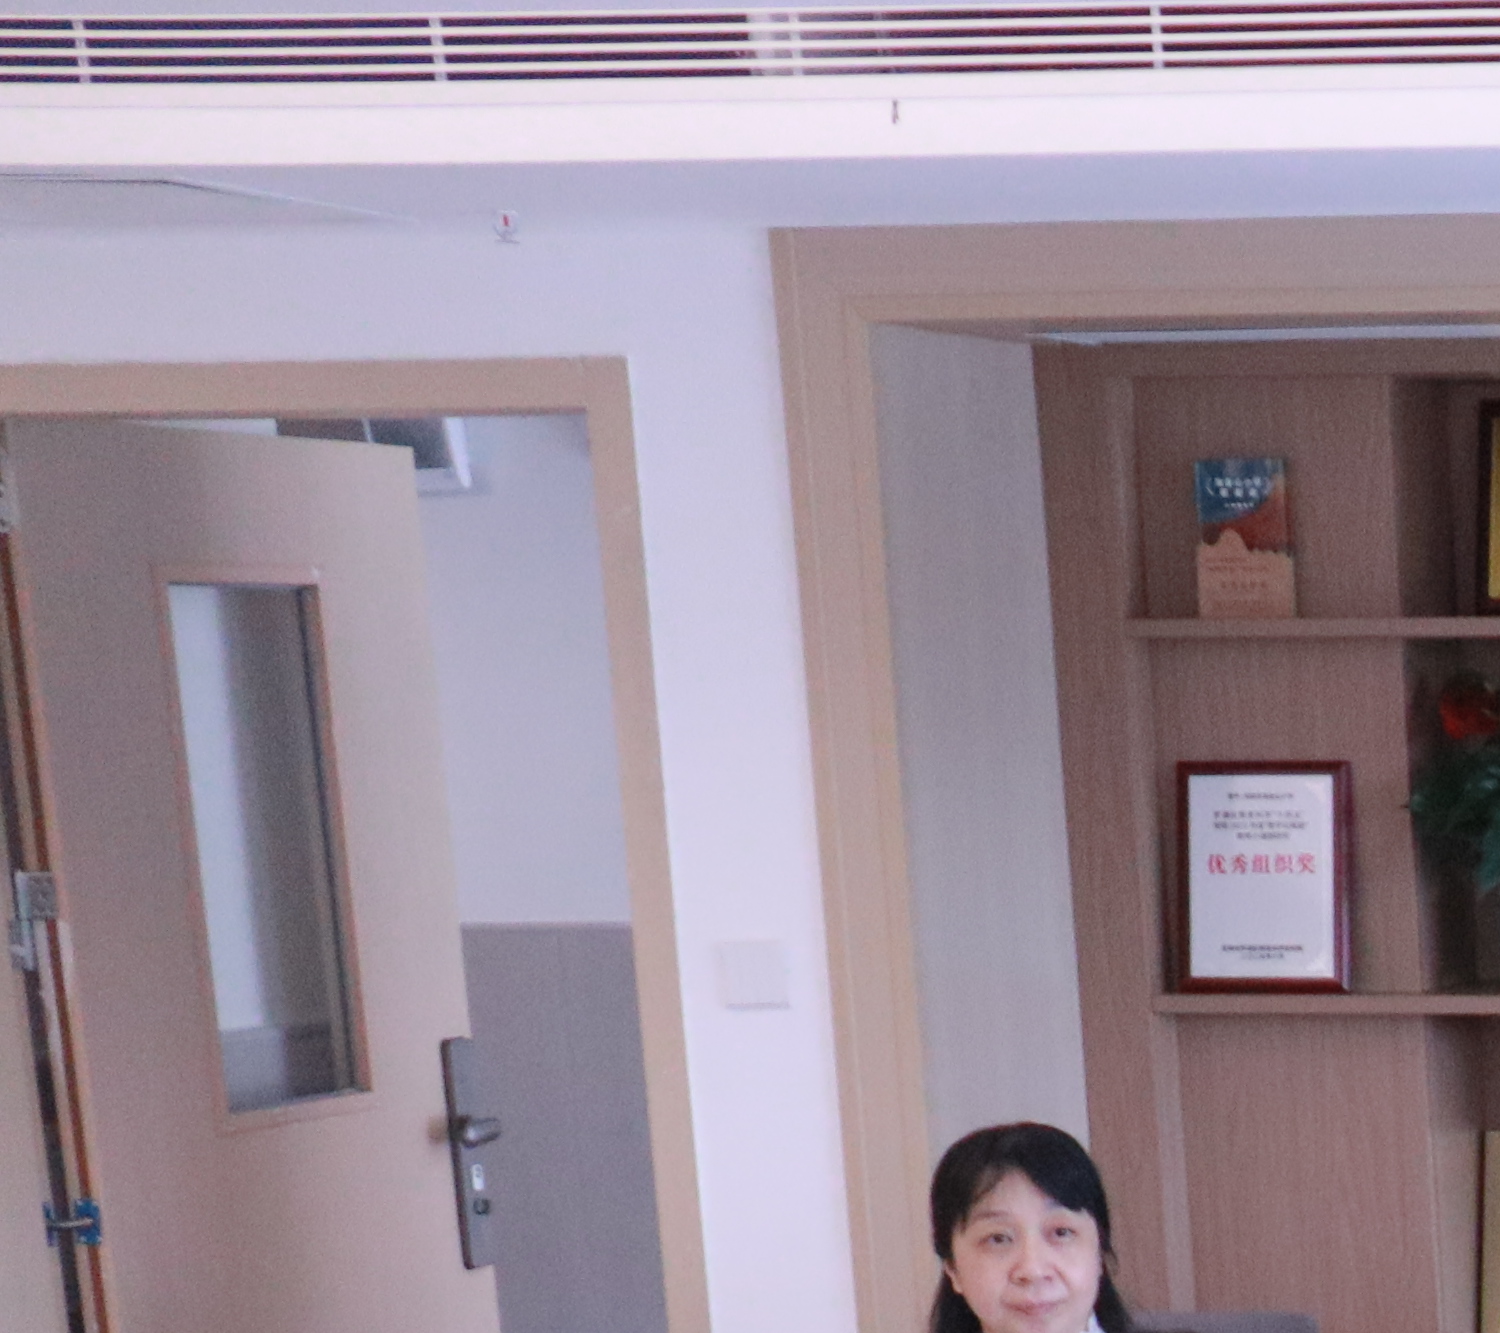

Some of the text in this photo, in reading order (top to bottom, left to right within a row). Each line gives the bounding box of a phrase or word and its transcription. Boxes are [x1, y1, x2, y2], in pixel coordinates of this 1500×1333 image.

[1208, 853, 1318, 875] 优秀组织奖
